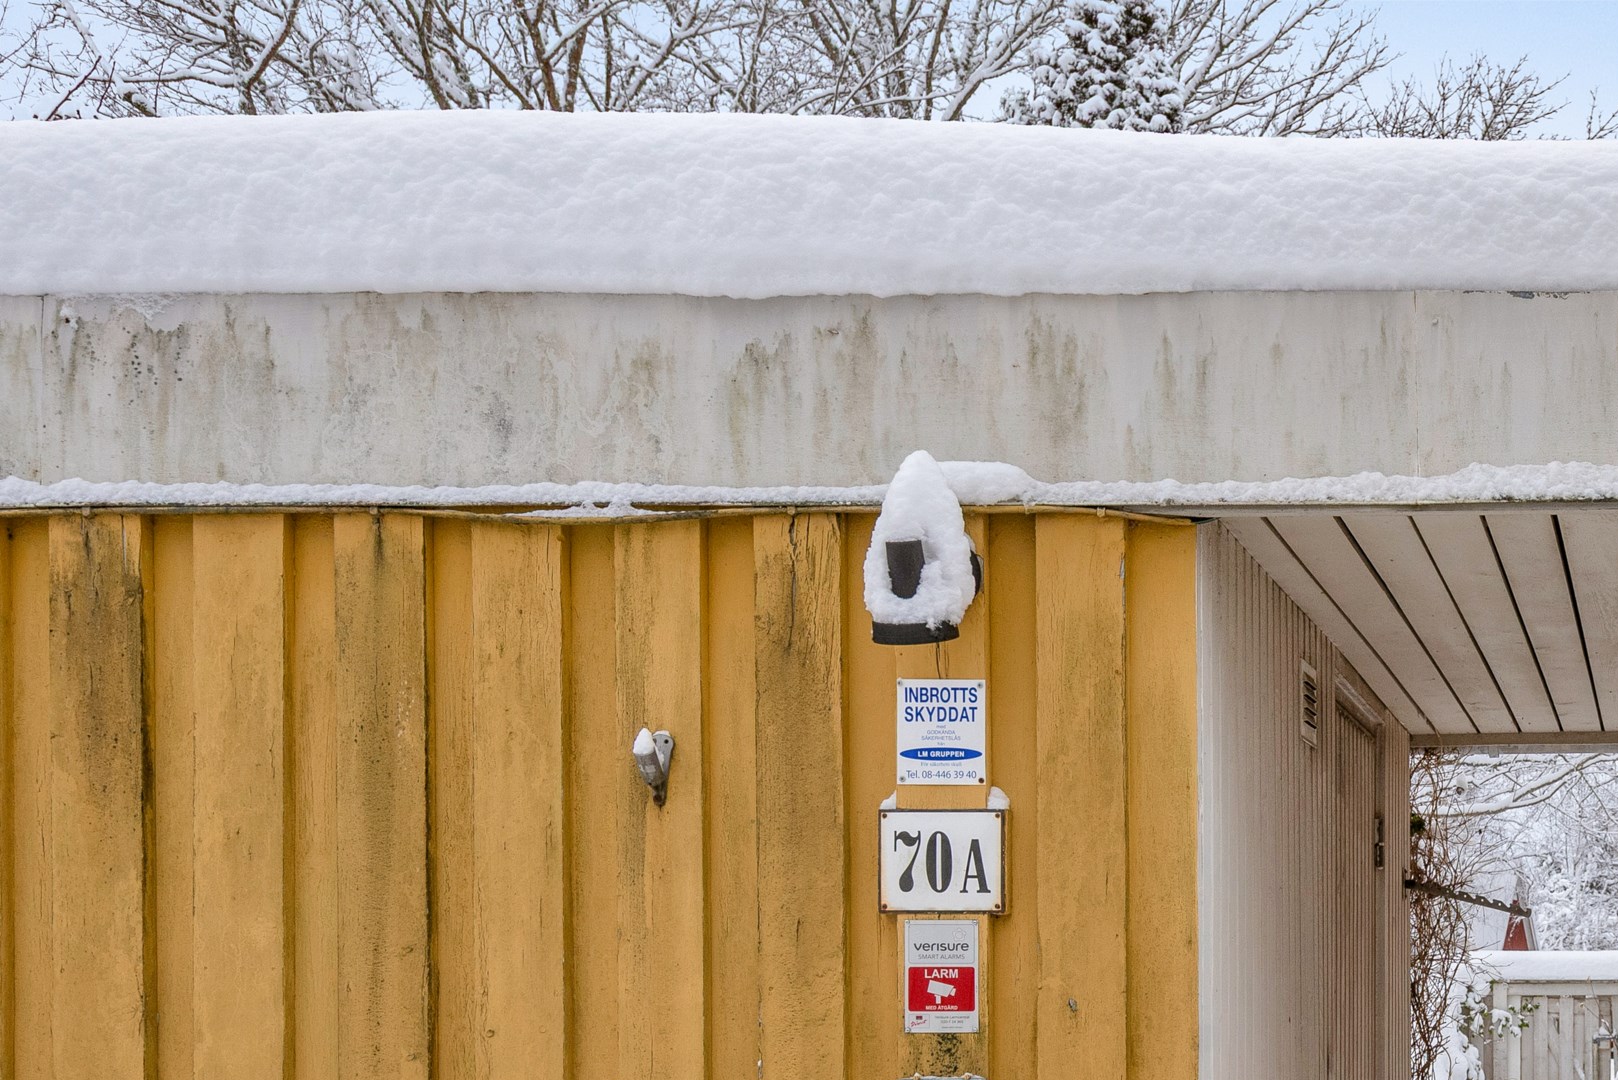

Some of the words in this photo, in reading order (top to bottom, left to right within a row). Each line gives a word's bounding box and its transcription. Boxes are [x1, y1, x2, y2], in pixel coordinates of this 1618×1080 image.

[904, 687, 978, 703] INBROTTS
[904, 706, 978, 722] SKYDDAT
[917, 750, 928, 758] LM
[929, 750, 965, 758] GRUPPEN
[906, 770, 920, 779] Tel.
[921, 770, 952, 779] 08-446
[953, 770, 964, 779] 39
[966, 770, 977, 779] 40
[913, 942, 970, 952] verisure
[924, 968, 959, 979] LARM
